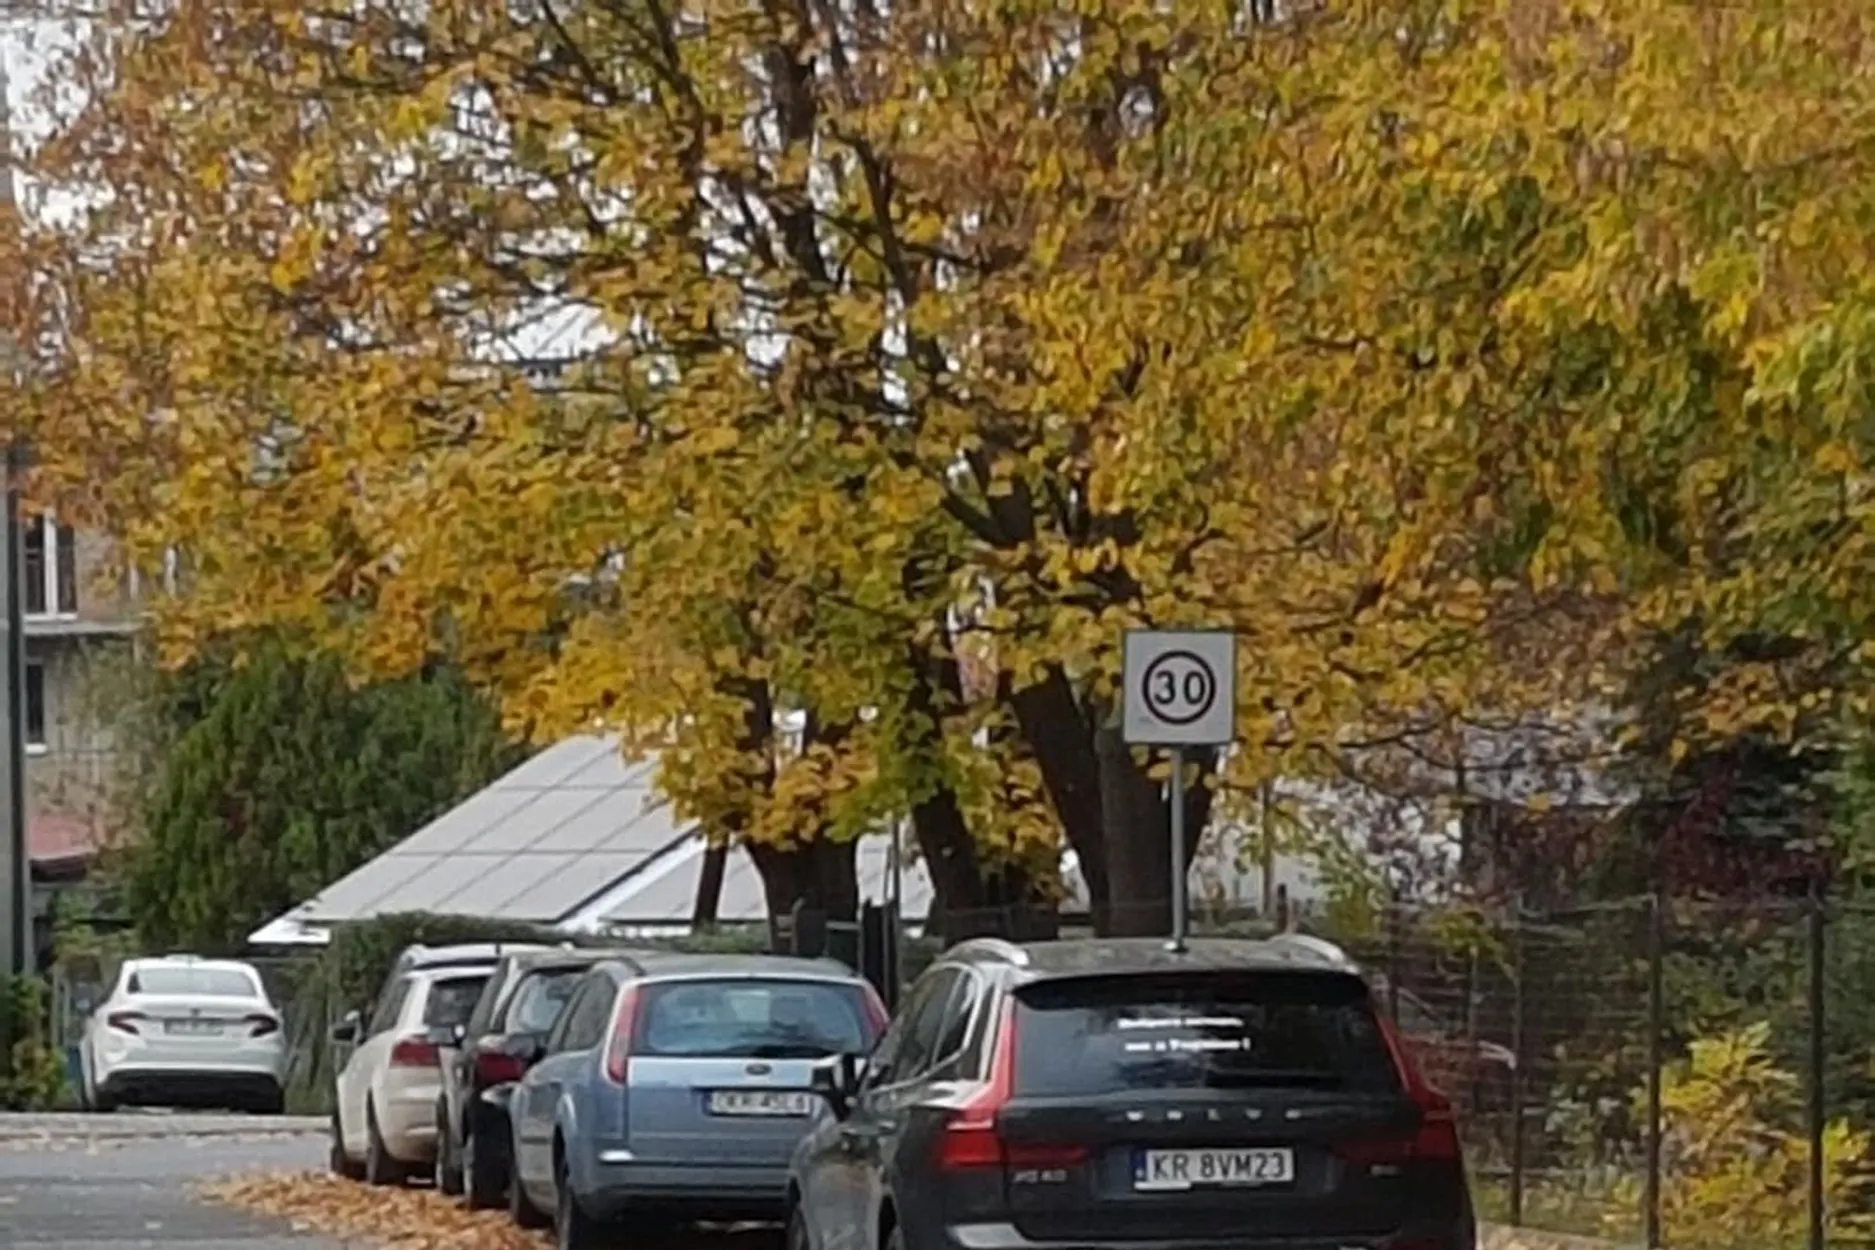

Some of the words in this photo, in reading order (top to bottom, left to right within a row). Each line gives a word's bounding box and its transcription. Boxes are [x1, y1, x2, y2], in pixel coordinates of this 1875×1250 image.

[1155, 670, 1205, 705] 30
[1154, 1154, 1190, 1180] KR
[1200, 1153, 1286, 1179] 8VM23
